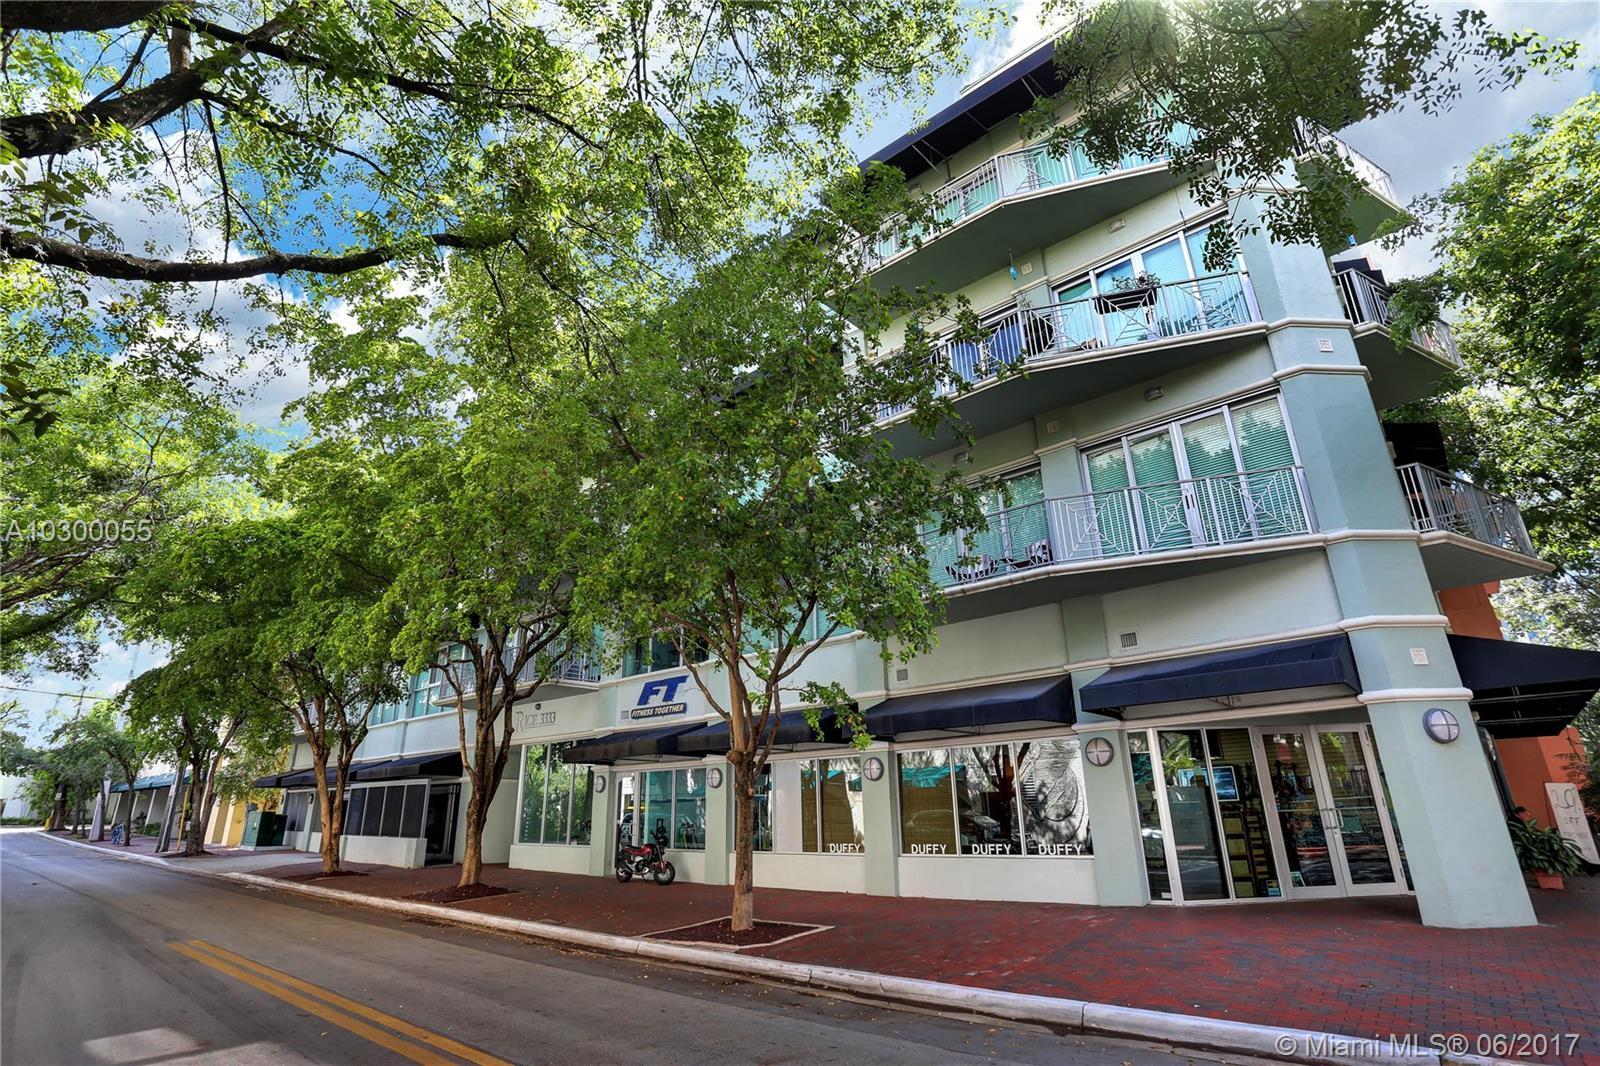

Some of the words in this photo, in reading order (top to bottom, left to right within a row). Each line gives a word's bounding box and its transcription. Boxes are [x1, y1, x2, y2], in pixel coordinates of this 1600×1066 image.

[637, 675, 690, 706] FT
[631, 708, 654, 718] FITNESS
[654, 704, 684, 715] TOGETHER
[829, 843, 860, 853] DUFFY
[911, 844, 947, 854] DUFFY
[971, 844, 1011, 855] DUFFY
[1038, 844, 1082, 855] DUFFY
